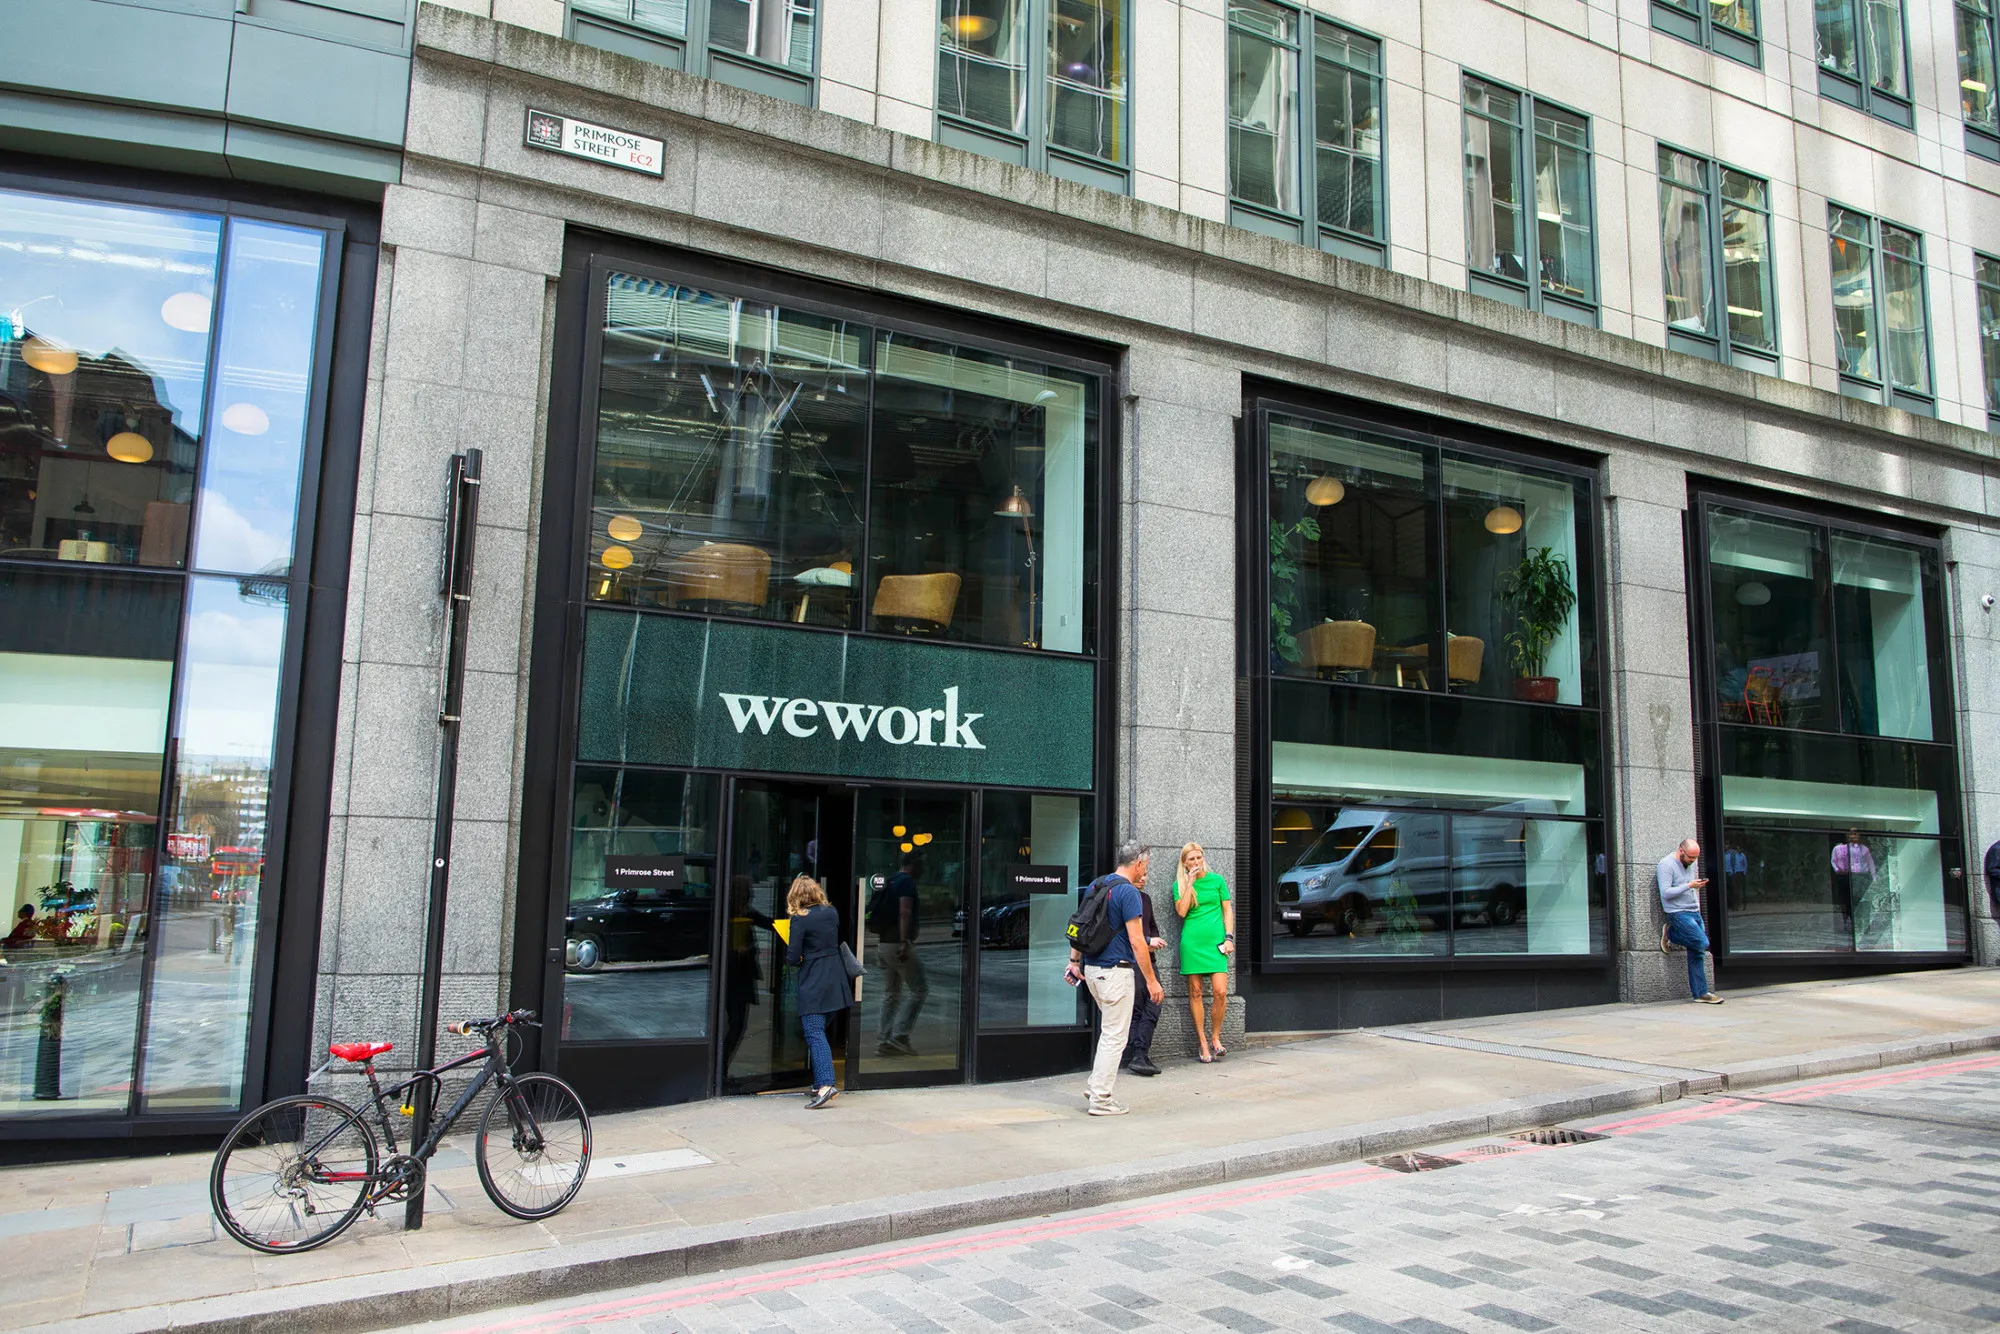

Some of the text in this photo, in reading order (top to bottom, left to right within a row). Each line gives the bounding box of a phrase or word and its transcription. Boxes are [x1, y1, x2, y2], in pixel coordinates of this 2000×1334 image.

[575, 125, 641, 151] PRIMROSE
[574, 139, 653, 167] STREET EC2
[719, 685, 987, 750] wework
[620, 868, 652, 877] Primrose
[653, 869, 674, 877] Street
[1044, 876, 1061, 884] Street
